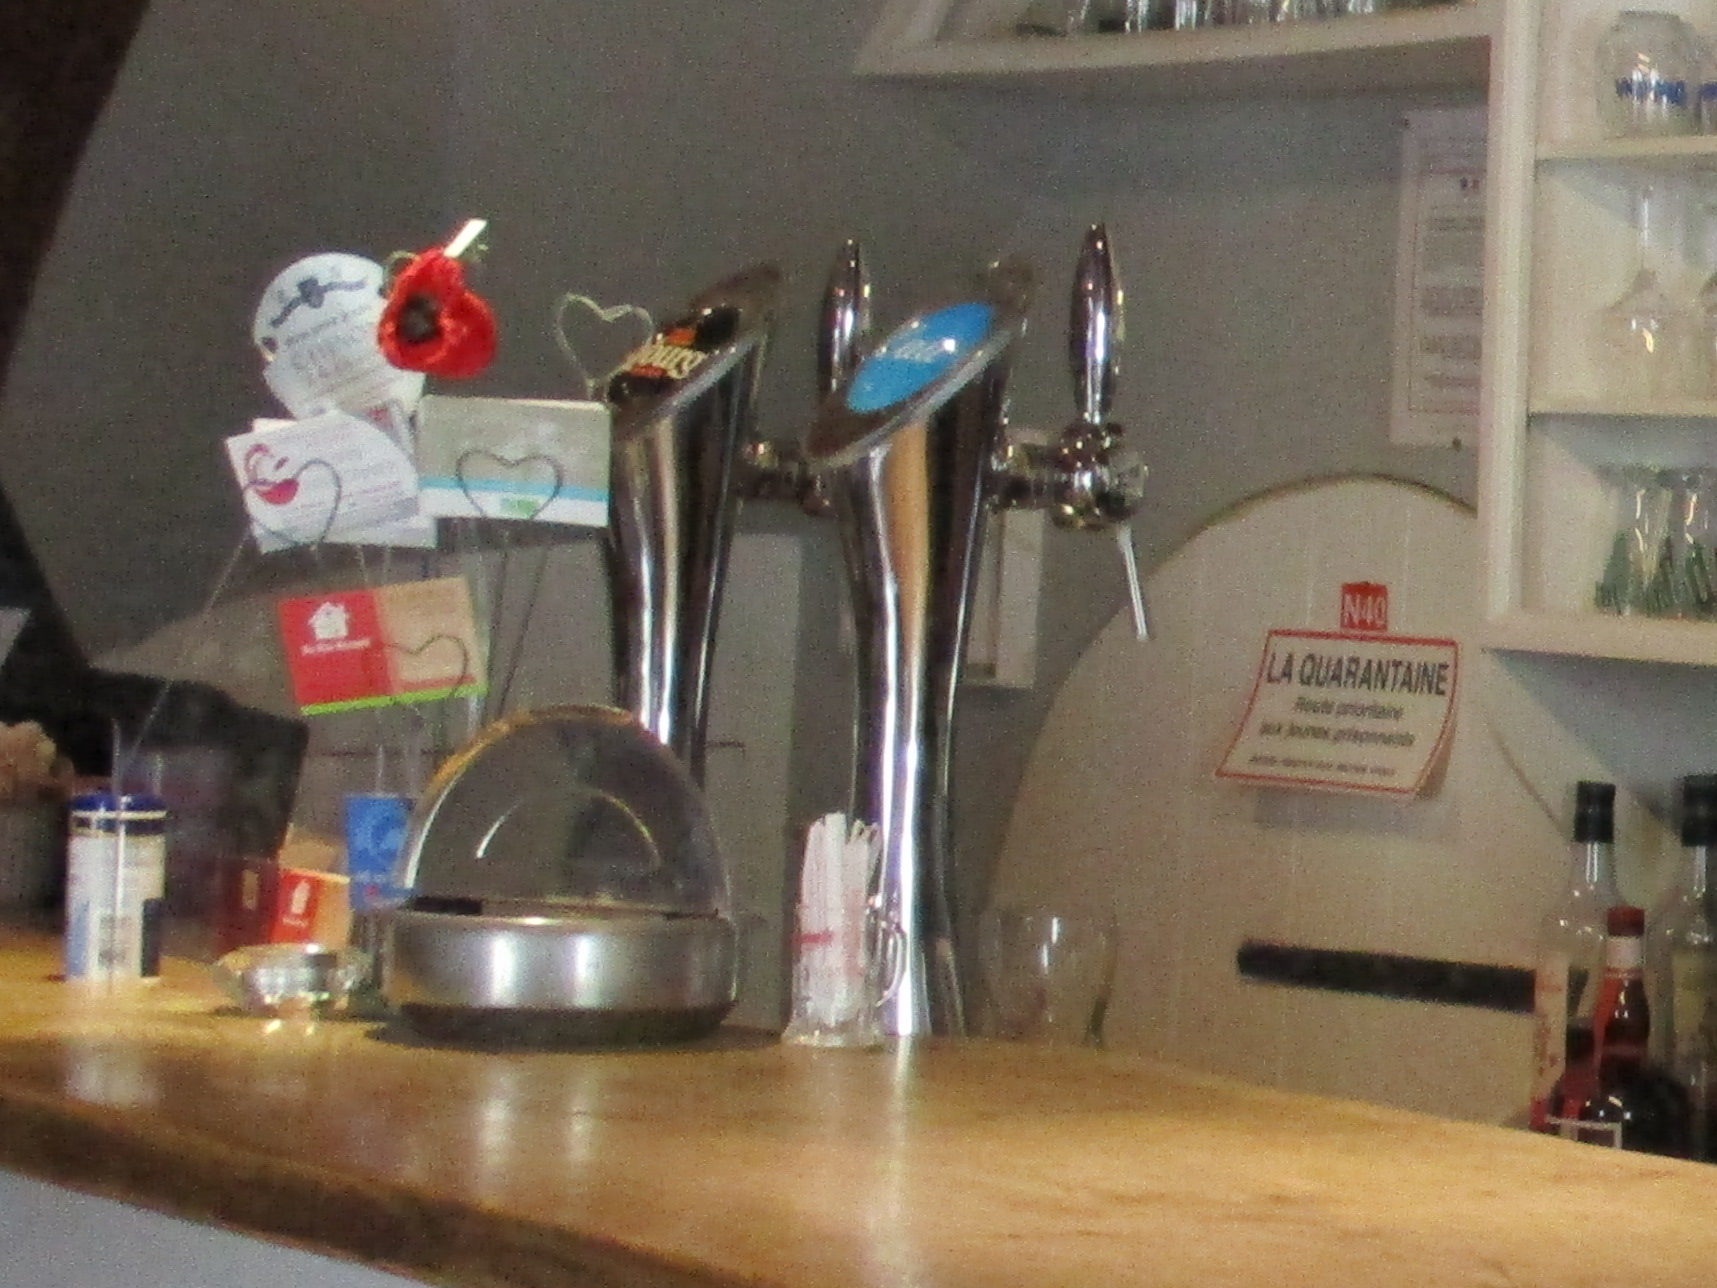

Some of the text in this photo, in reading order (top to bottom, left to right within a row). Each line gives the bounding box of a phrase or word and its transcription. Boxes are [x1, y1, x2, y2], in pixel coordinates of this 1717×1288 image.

[1343, 593, 1387, 627] N40
[1266, 651, 1451, 696] LA QUARANTAINE
